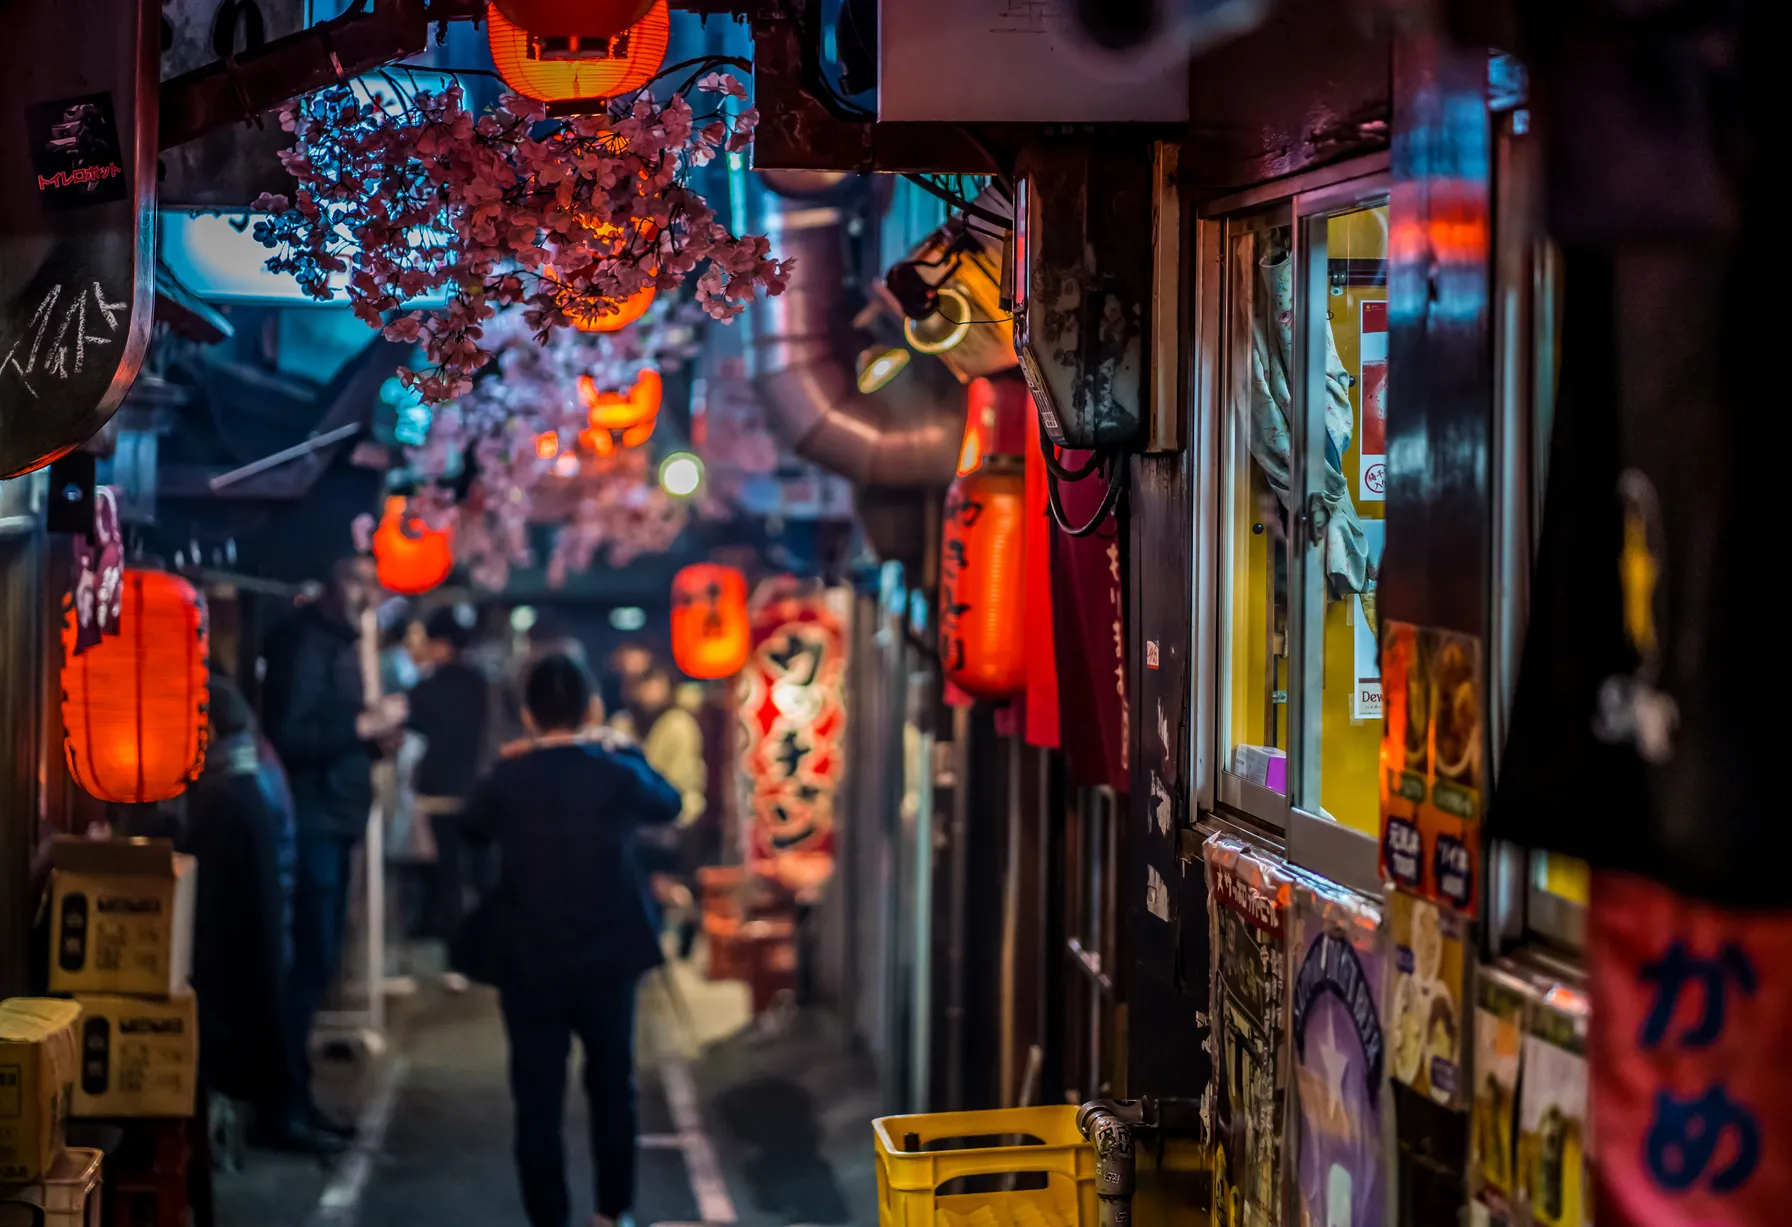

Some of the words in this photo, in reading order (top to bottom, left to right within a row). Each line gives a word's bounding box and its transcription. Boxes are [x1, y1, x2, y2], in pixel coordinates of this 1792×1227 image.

[38, 161, 122, 191] トイレロボット
[1638, 936, 1760, 1194] かめ
